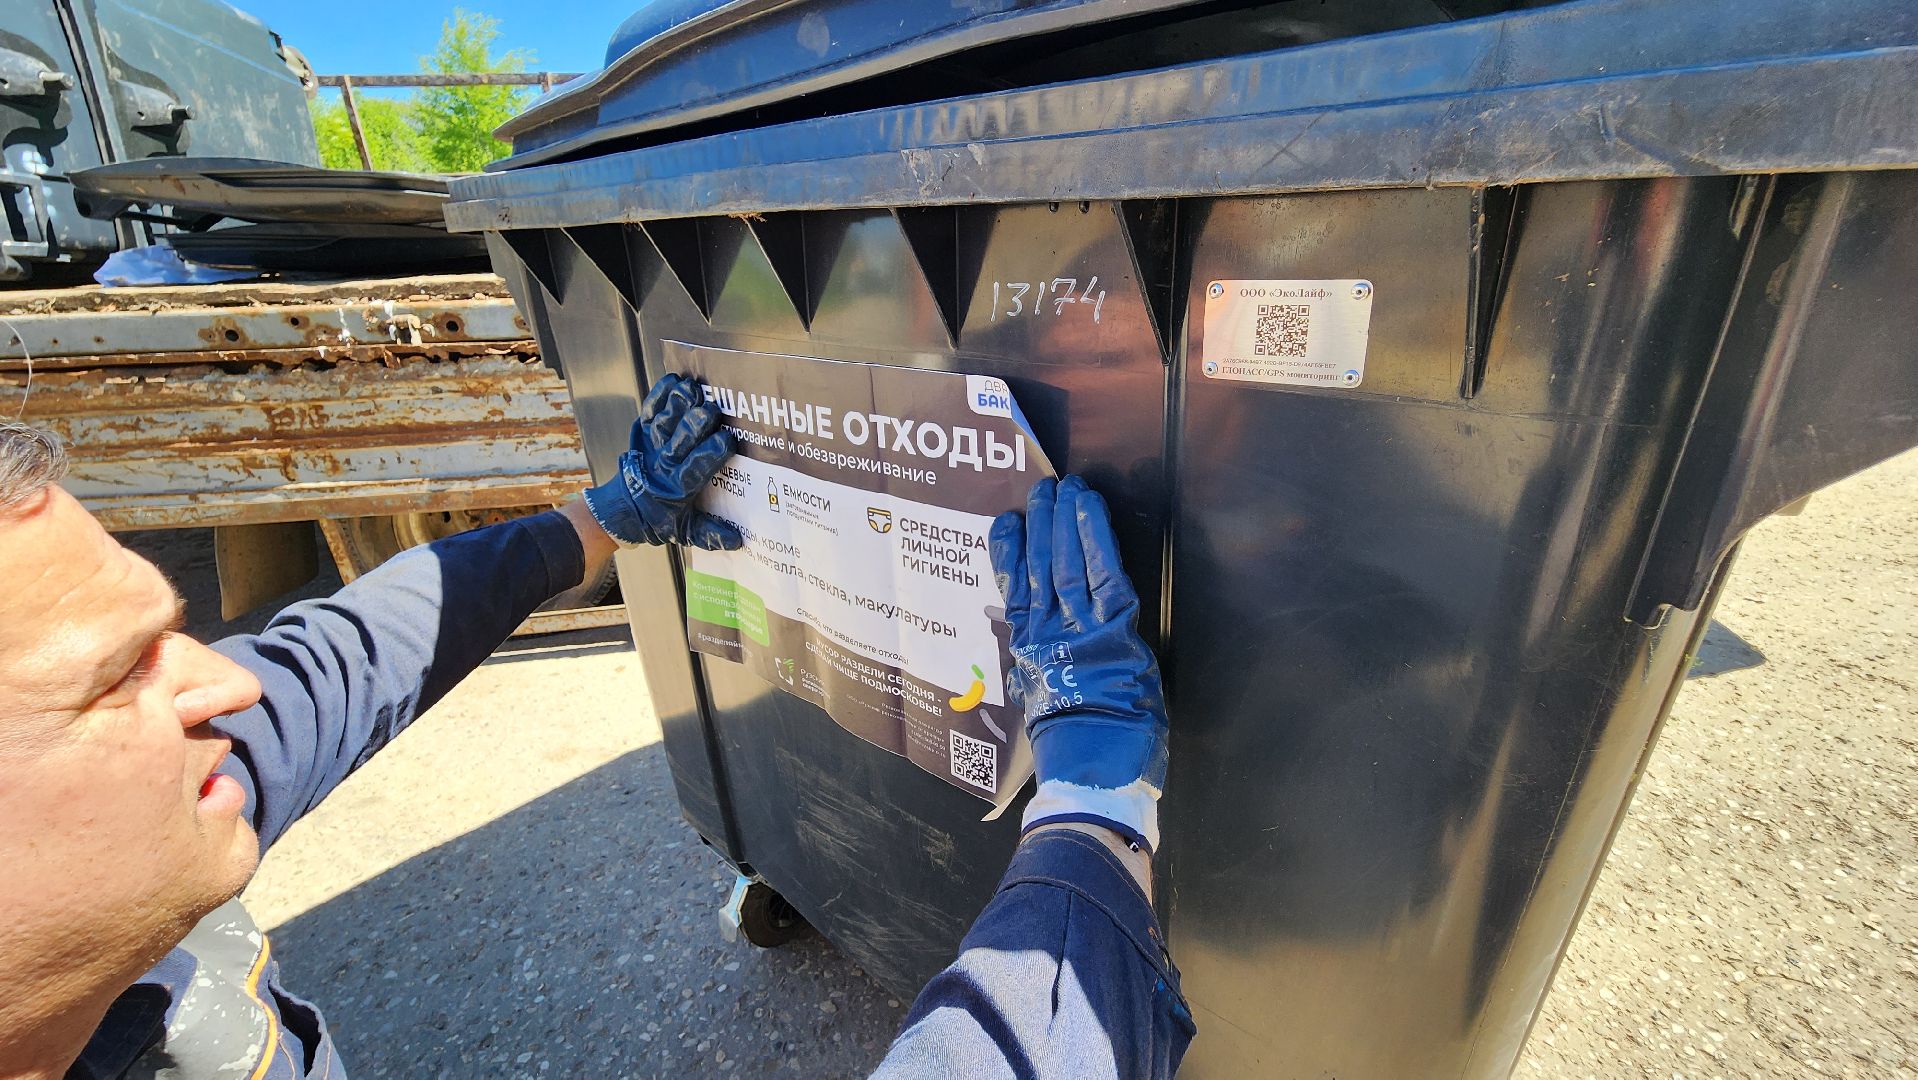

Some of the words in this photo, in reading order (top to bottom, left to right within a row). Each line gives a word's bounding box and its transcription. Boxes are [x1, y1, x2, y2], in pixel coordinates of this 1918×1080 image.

[990, 276, 1107, 324] 13174
[1240, 288, 1266, 298] ООО
[1269, 288, 1333, 300] «ЭкоЛайф»
[977, 393, 1010, 410] БАК
[700, 384, 834, 440] ЕШАННЫЕ
[842, 410, 1026, 472] ОТХОДЫ
[720, 423, 785, 450] стирование
[787, 440, 795, 453] и
[797, 442, 937, 485] обезвреживание
[719, 466, 752, 486] ЩЕВЫЕ
[783, 483, 831, 512] ЕМКОСТИ
[761, 537, 801, 558] кроме
[899, 517, 987, 551] СРЕДСТВА
[901, 537, 970, 567] ЛИЧНОЙ
[902, 554, 979, 587] ГИГИЕНЫ
[756, 552, 806, 582] металла,
[808, 574, 851, 606] стекла,
[855, 595, 957, 638] макулатуры
[841, 655, 885, 680] РАЗДЕЛИ
[887, 673, 935, 702] СЕГОДНЯ
[860, 674, 943, 718] ПОДМОСКОВЬЕ!
